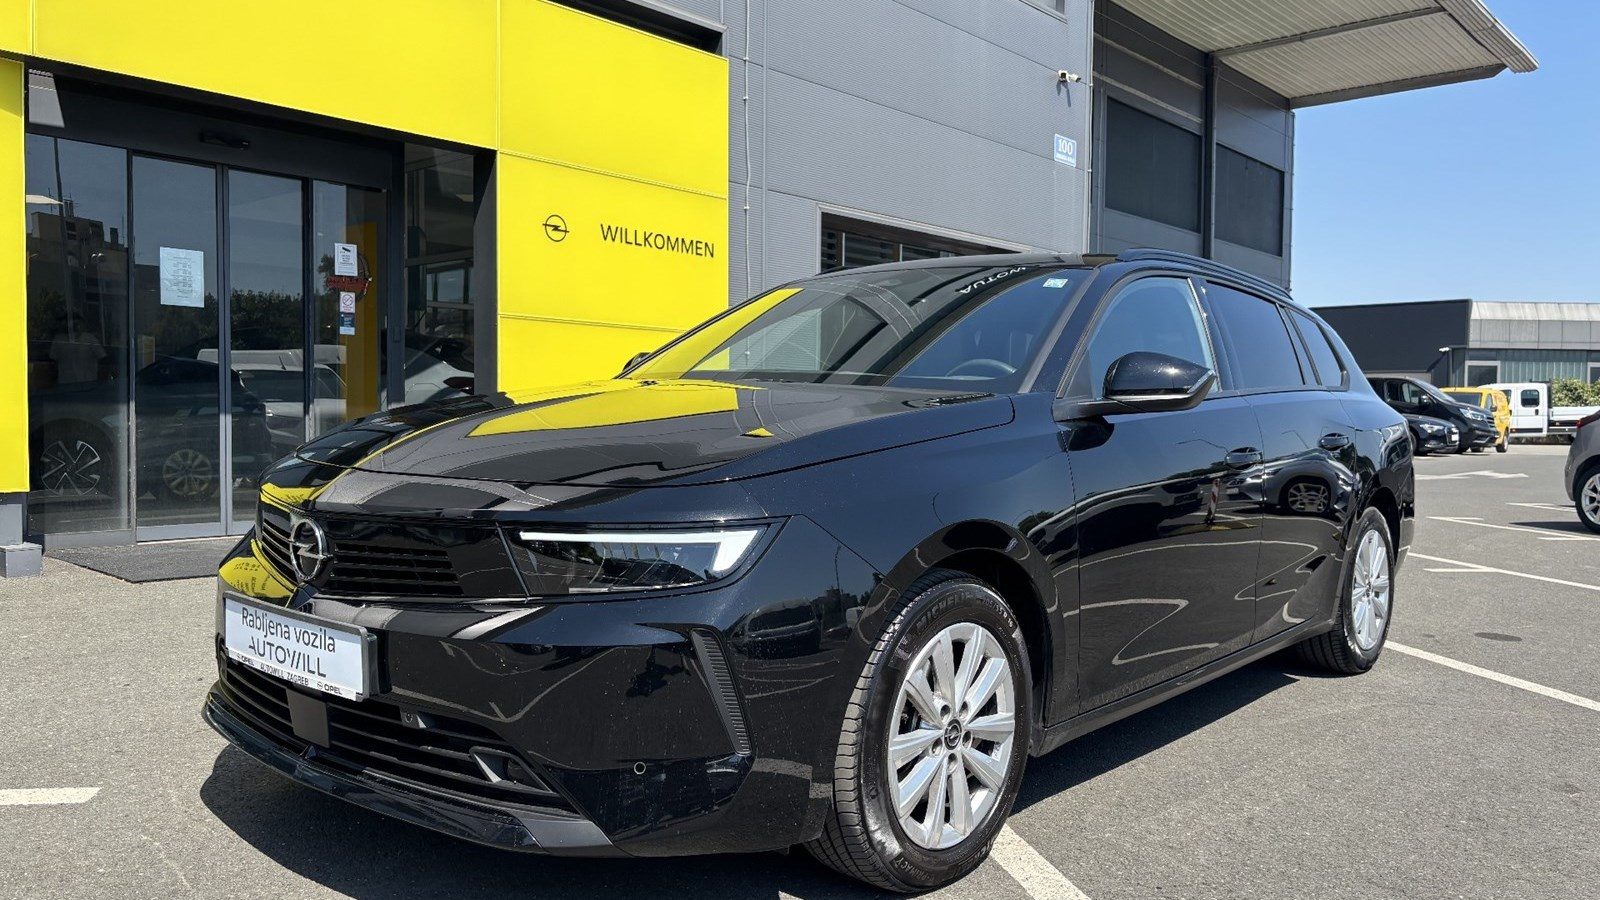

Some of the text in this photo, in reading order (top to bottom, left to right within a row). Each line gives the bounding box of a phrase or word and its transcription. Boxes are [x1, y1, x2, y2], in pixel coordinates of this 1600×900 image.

[1058, 139, 1073, 155] 100
[600, 223, 715, 258] WILLKOMMEN
[242, 607, 336, 653] Rabljena vozila
[286, 672, 309, 686] ZAGREB
[324, 683, 343, 696] OPEL
